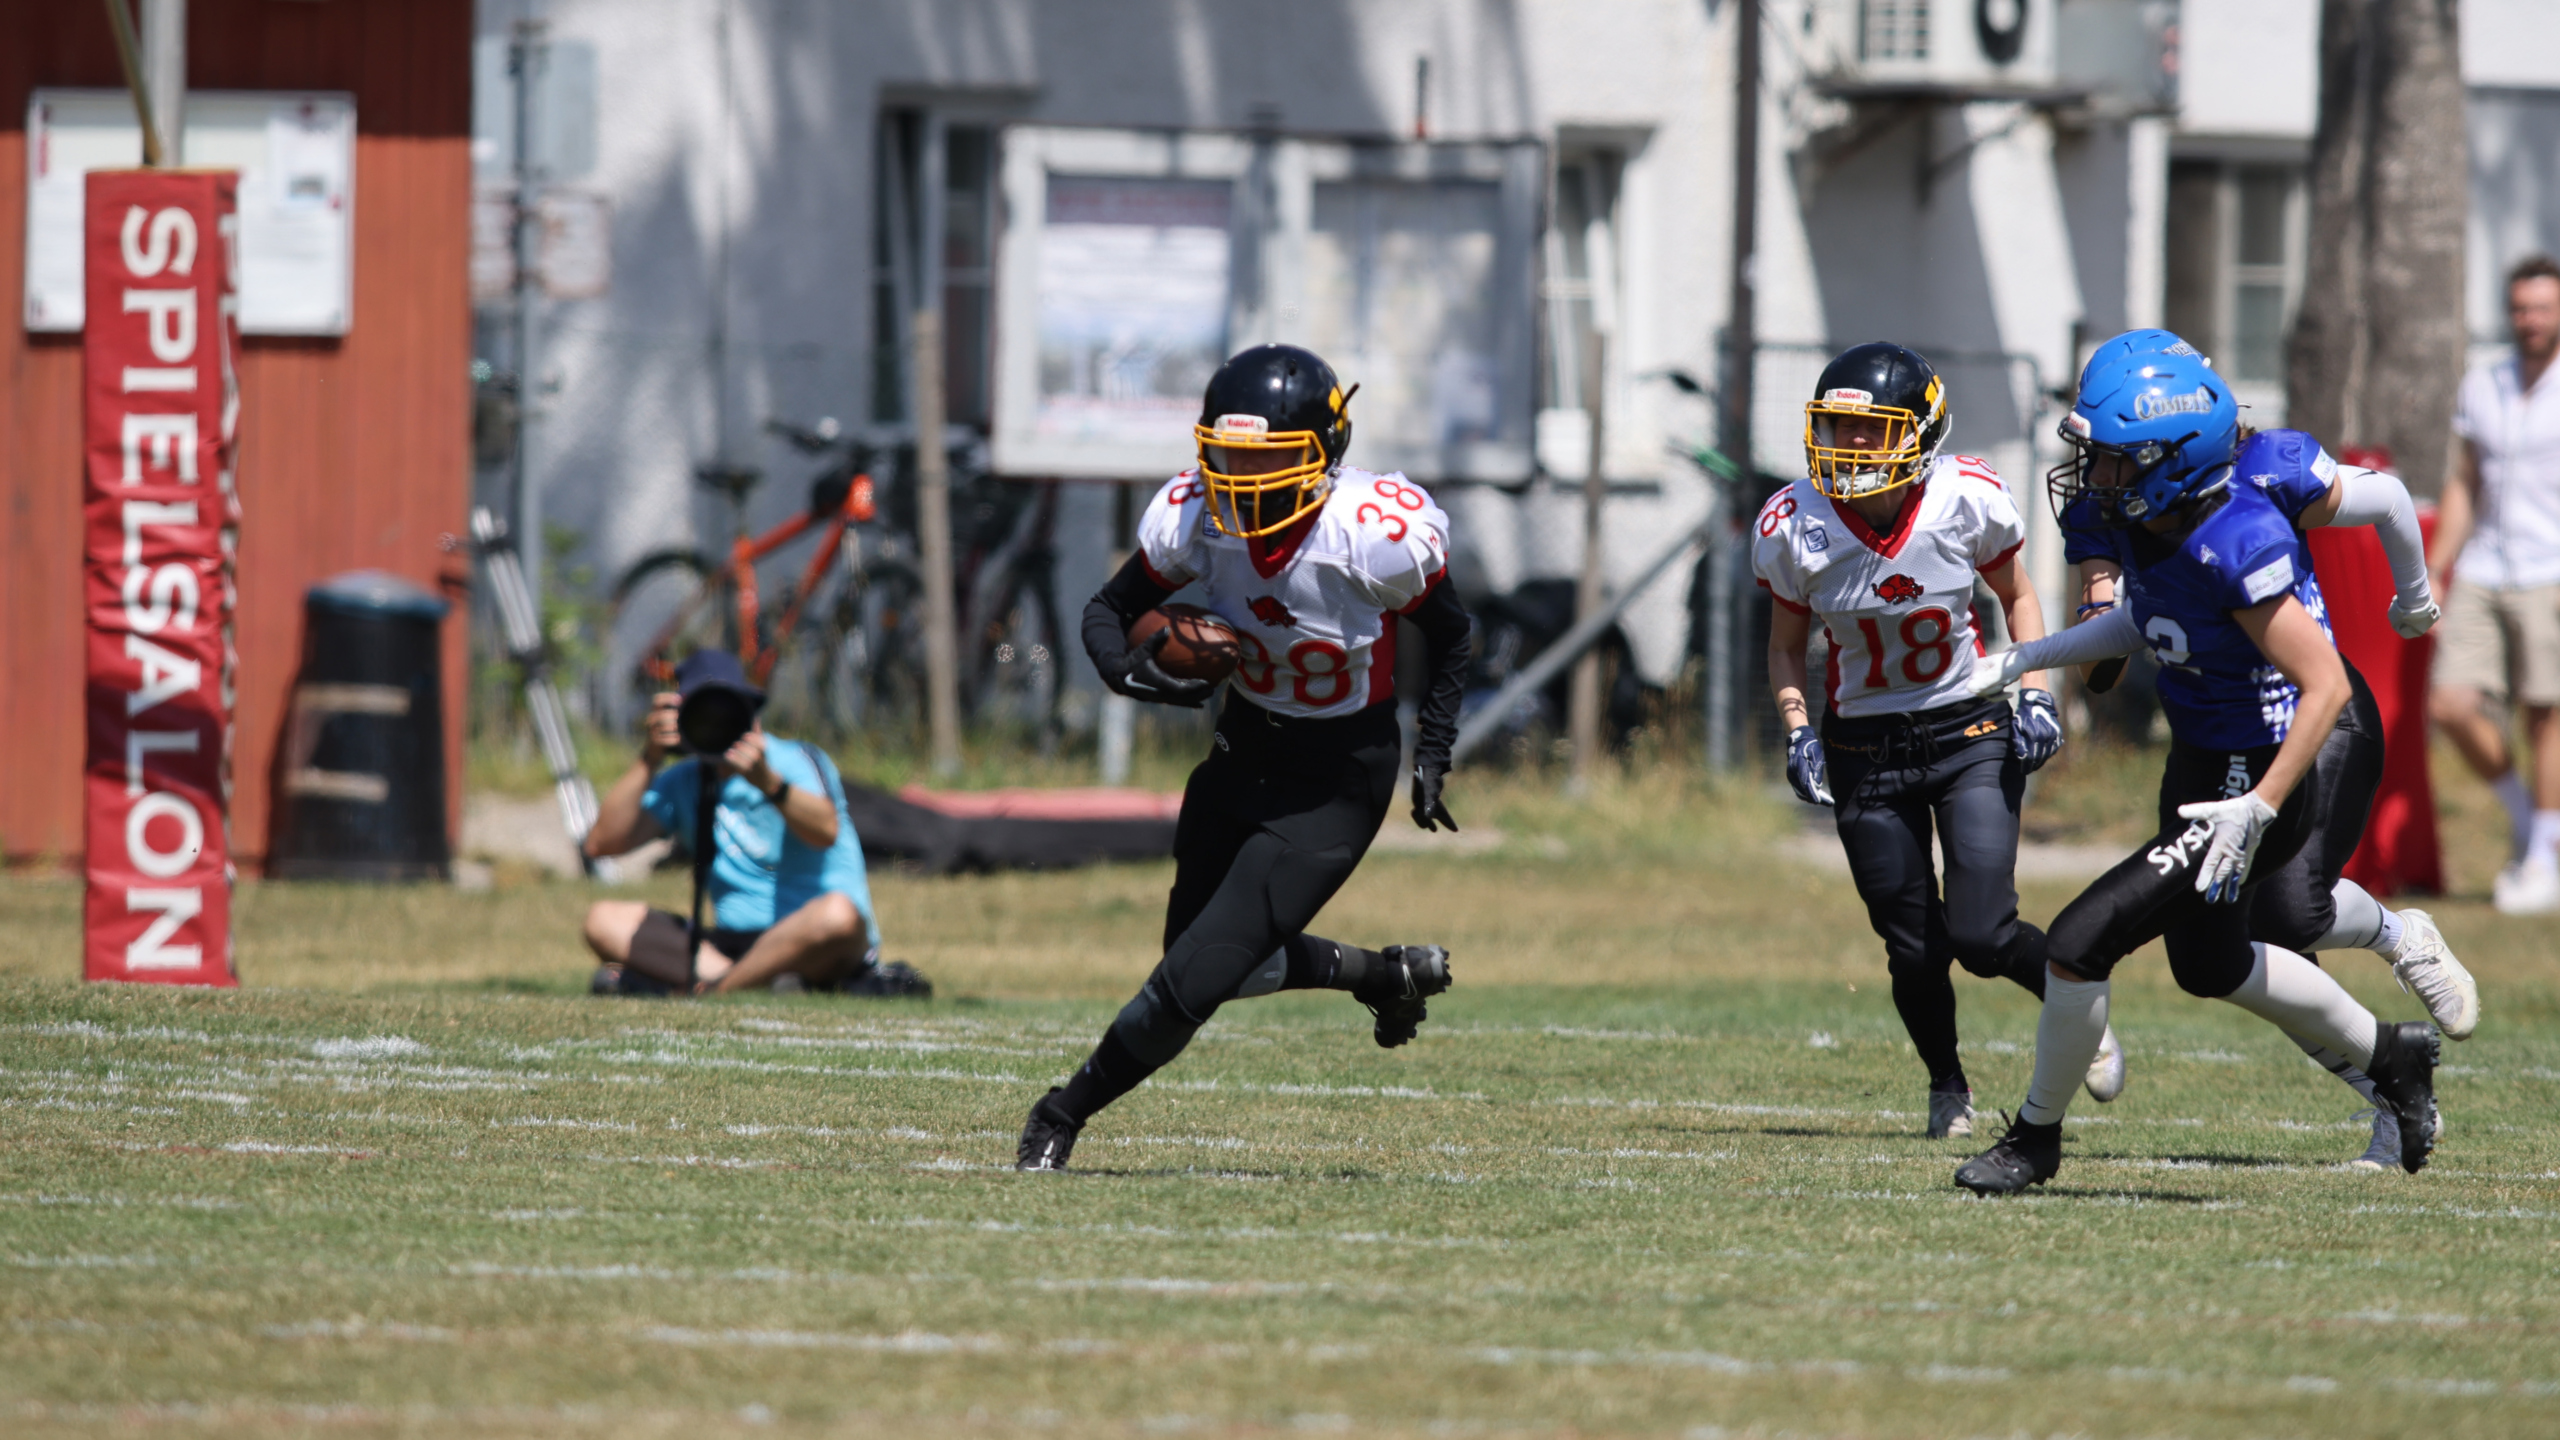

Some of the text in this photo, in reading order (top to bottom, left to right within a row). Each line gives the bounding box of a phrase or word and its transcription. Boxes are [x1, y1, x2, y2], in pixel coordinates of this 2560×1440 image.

[1837, 390, 1862, 399] Riddell
[1228, 419, 1255, 428] Riddell
[1954, 455, 2002, 491] 18
[1357, 479, 1424, 542] 38
[1758, 486, 1797, 538] 18
[121, 205, 204, 972] SPIELSALON
[1857, 607, 1953, 688] 18
